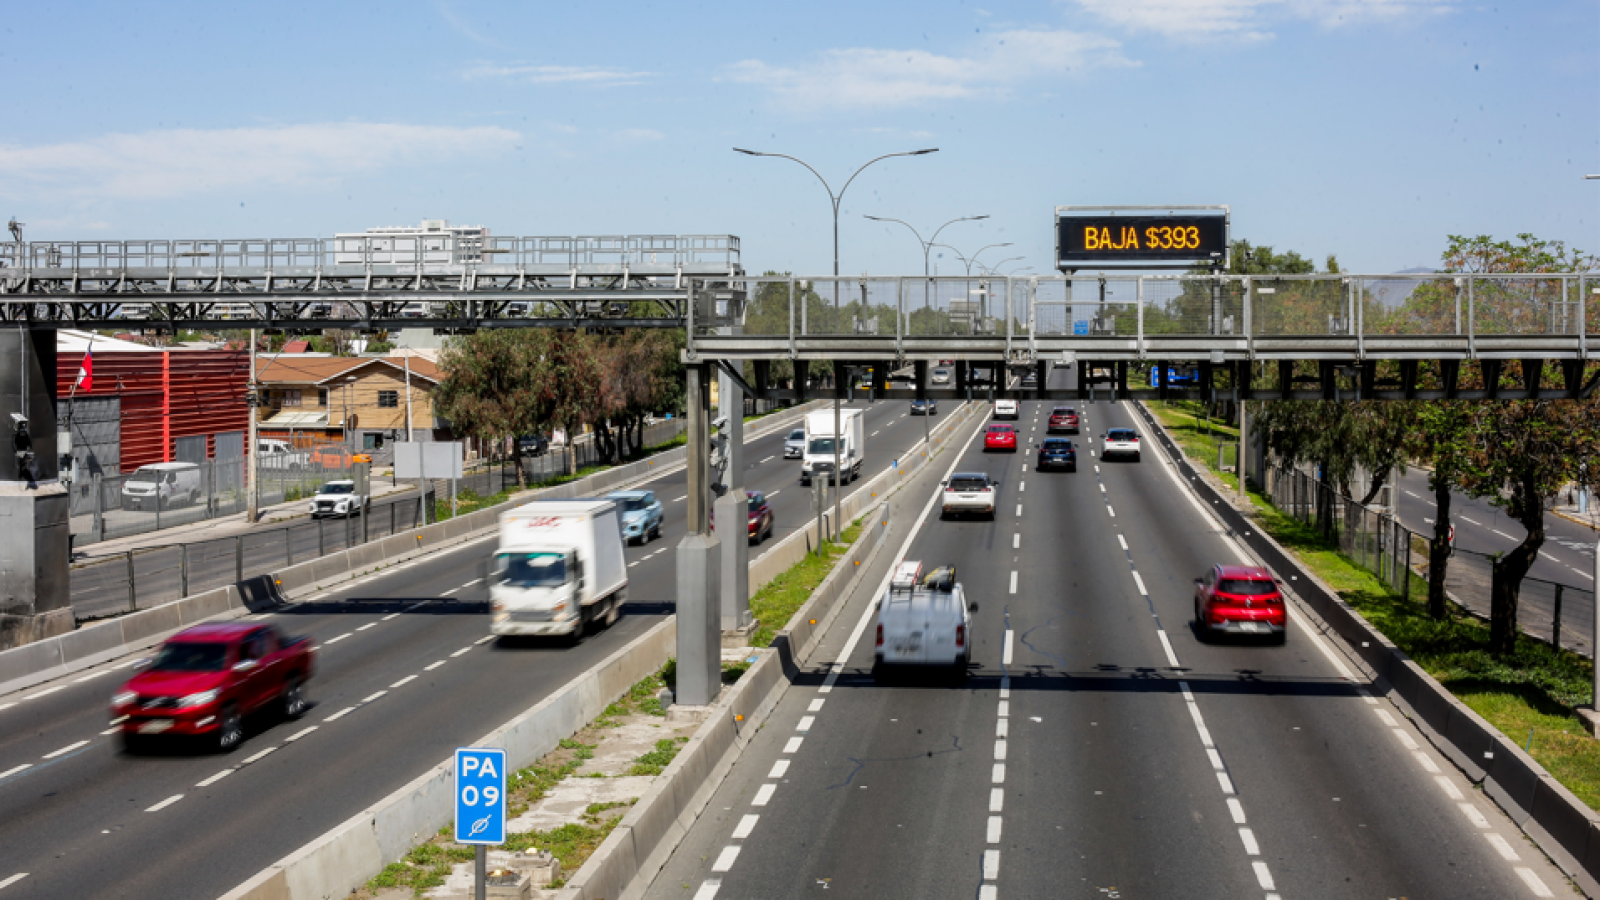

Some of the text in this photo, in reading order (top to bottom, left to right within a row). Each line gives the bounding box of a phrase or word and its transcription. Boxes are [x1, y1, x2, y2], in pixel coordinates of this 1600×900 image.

[1084, 226, 1200, 249] BAJA $393
[462, 756, 498, 778] PA
[461, 785, 500, 807] 09
